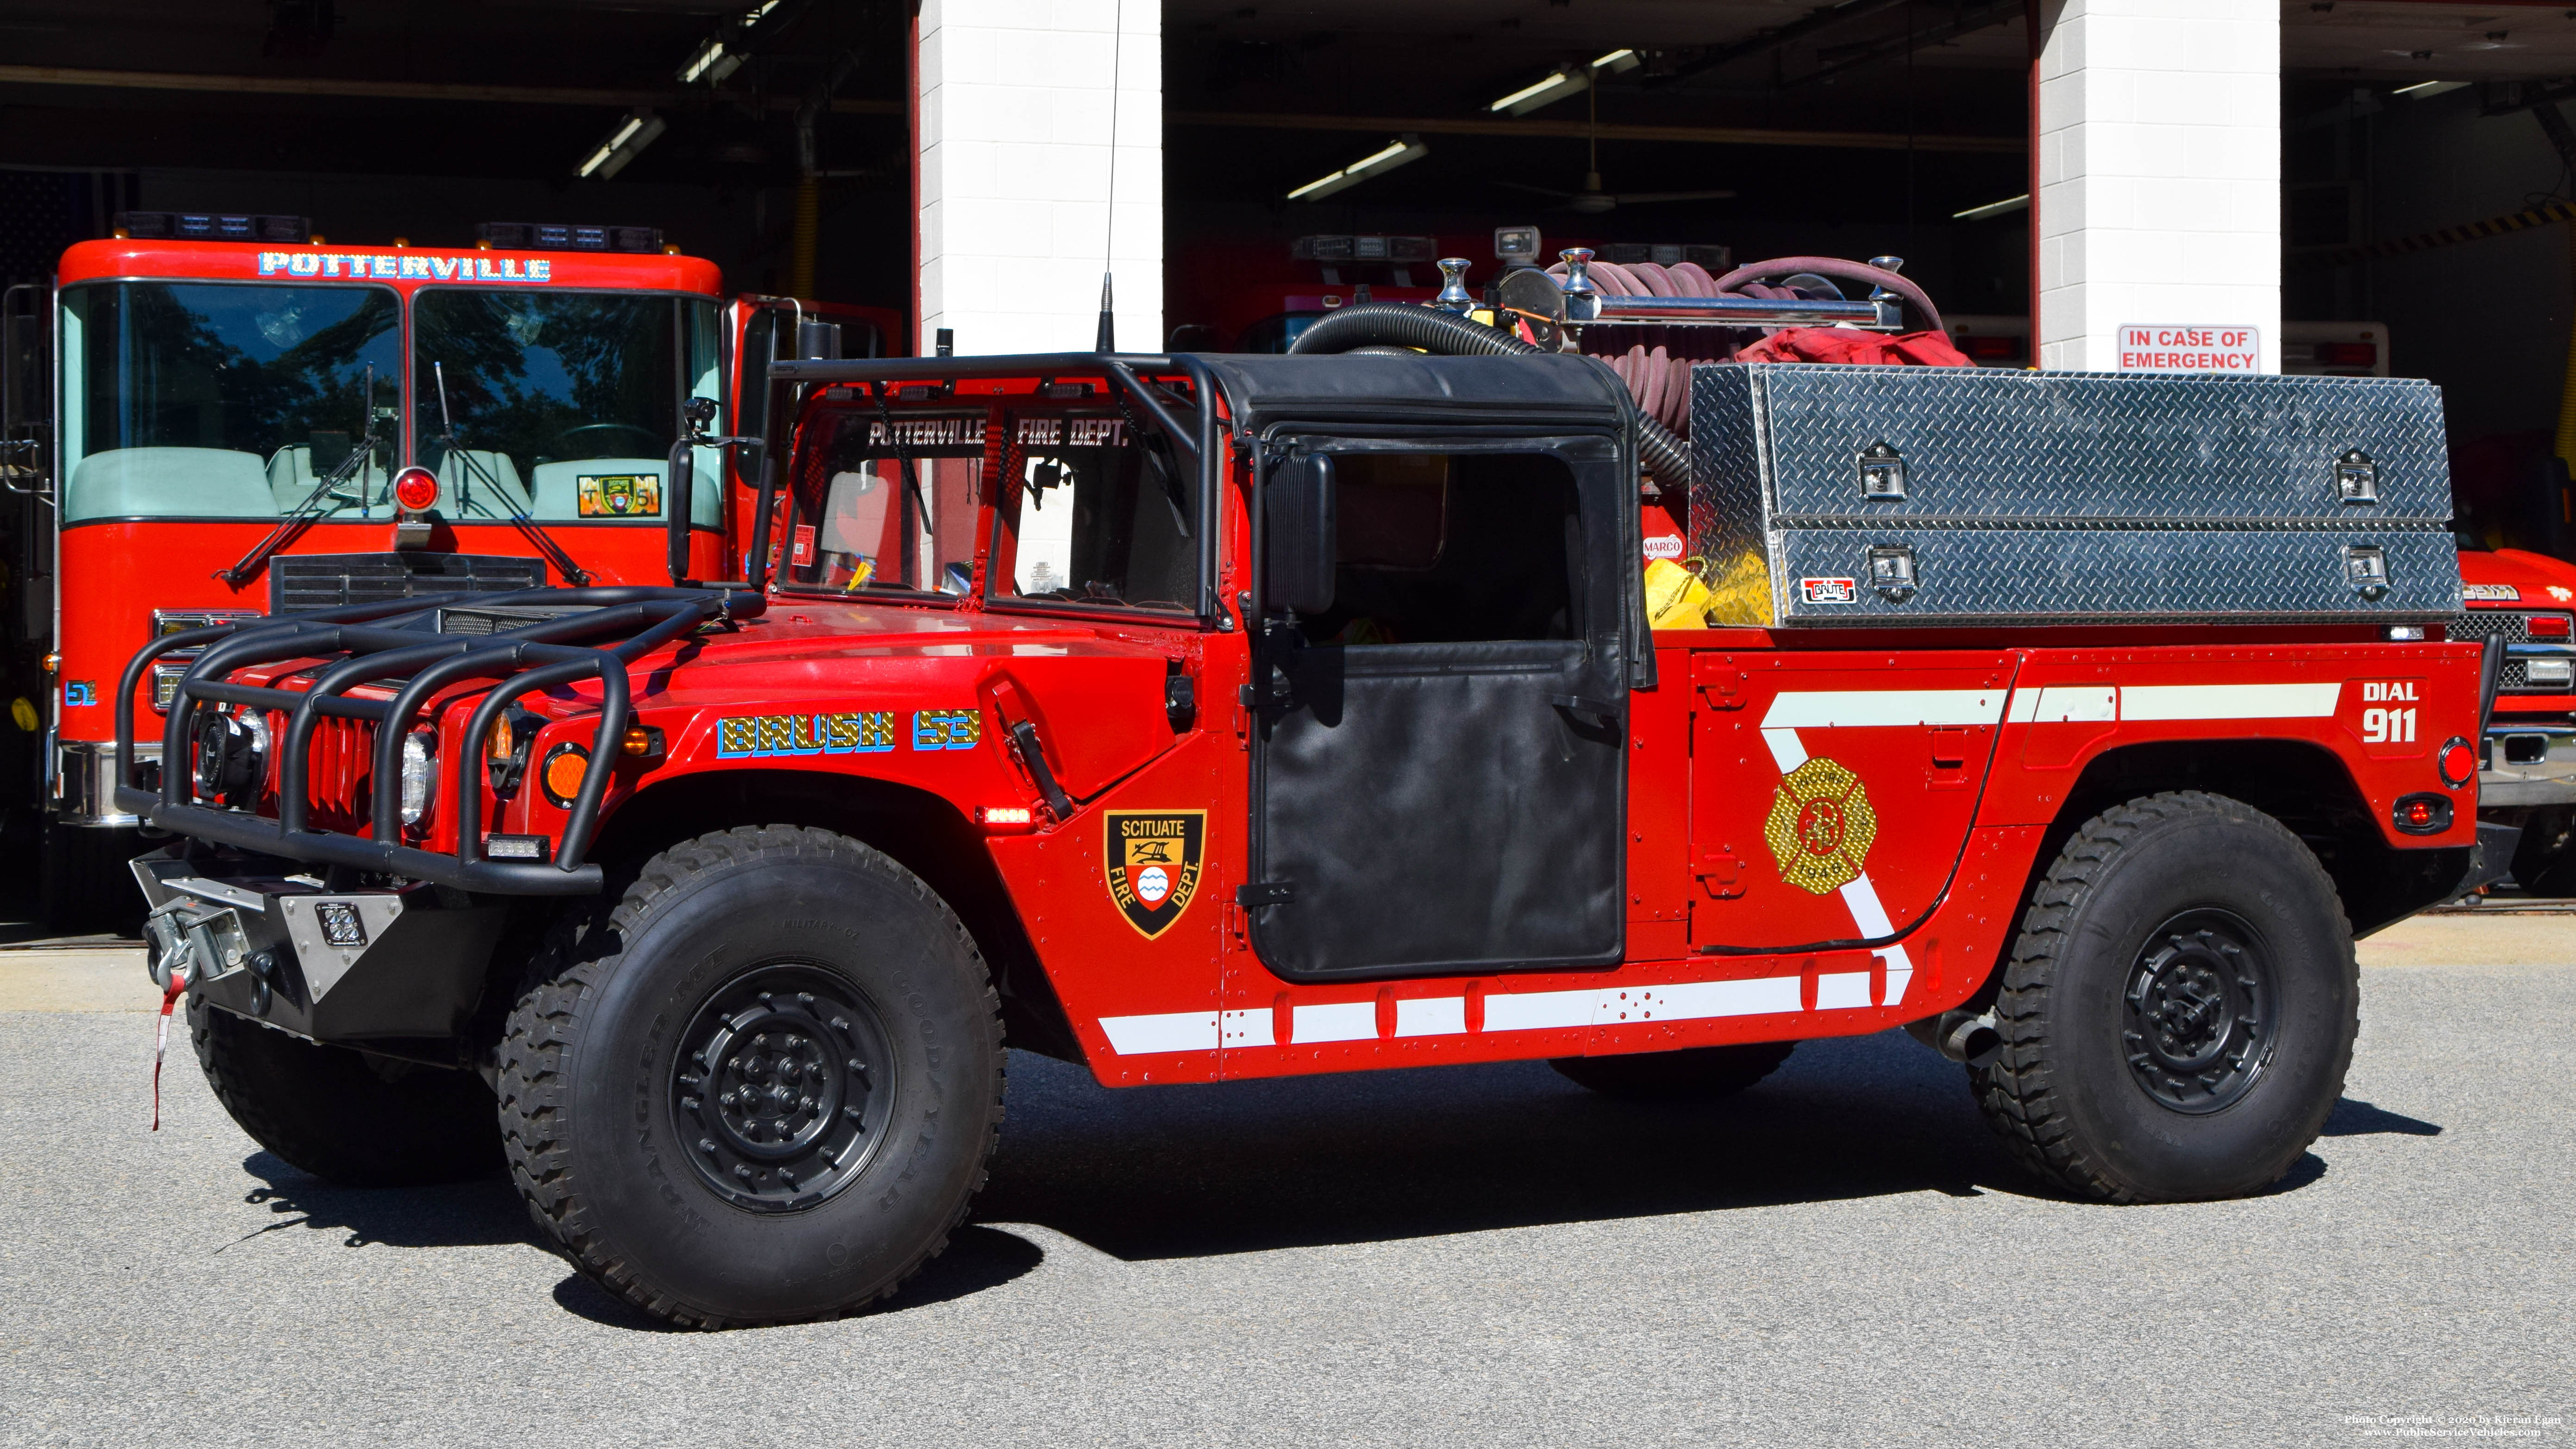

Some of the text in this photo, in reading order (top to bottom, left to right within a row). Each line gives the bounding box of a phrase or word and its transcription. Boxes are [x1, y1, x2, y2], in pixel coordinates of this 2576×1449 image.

[258, 252, 551, 282] POTTERVILLE
[2130, 331, 2248, 346] IN CASE OF
[2123, 352, 2254, 368] EMERGENCY
[869, 419, 1128, 446] POTTERVILLE FIRE DEPT.
[637, 489, 653, 506] 51
[1644, 542, 1680, 551] MARCO
[1815, 585, 1845, 595] BRUTE
[65, 680, 98, 706] 51
[2364, 683, 2419, 701] DIAL
[716, 709, 980, 759] BRUSH 53
[2363, 709, 2416, 742] 911
[1121, 820, 1185, 836] SCITUATE
[1800, 862, 1841, 879] 1948
[1111, 866, 1136, 909] FIRE
[1171, 861, 1199, 907] DEPT.
